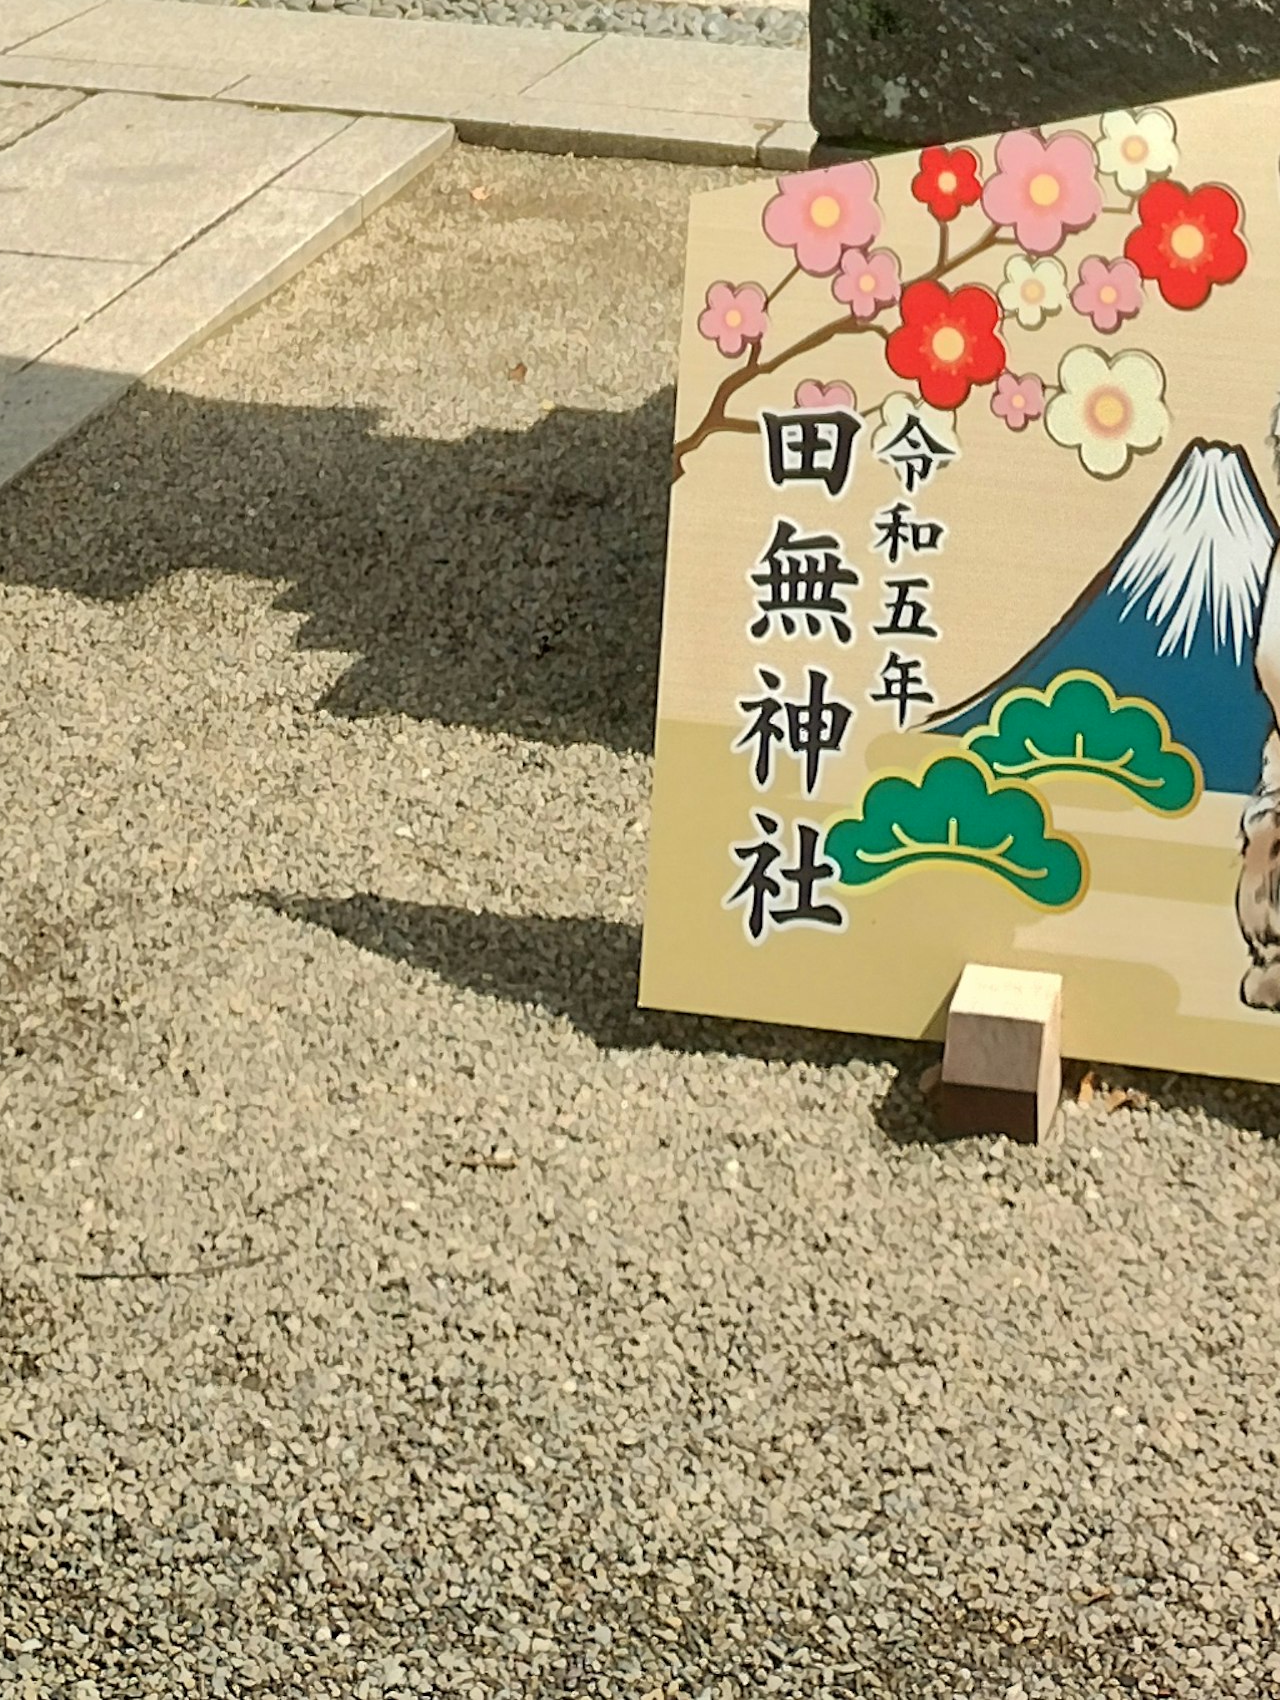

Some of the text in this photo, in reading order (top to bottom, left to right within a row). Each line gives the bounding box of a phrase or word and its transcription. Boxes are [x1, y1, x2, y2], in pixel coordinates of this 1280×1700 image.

[726, 409, 863, 941] 田無神社
[870, 412, 957, 732] 令和五年
